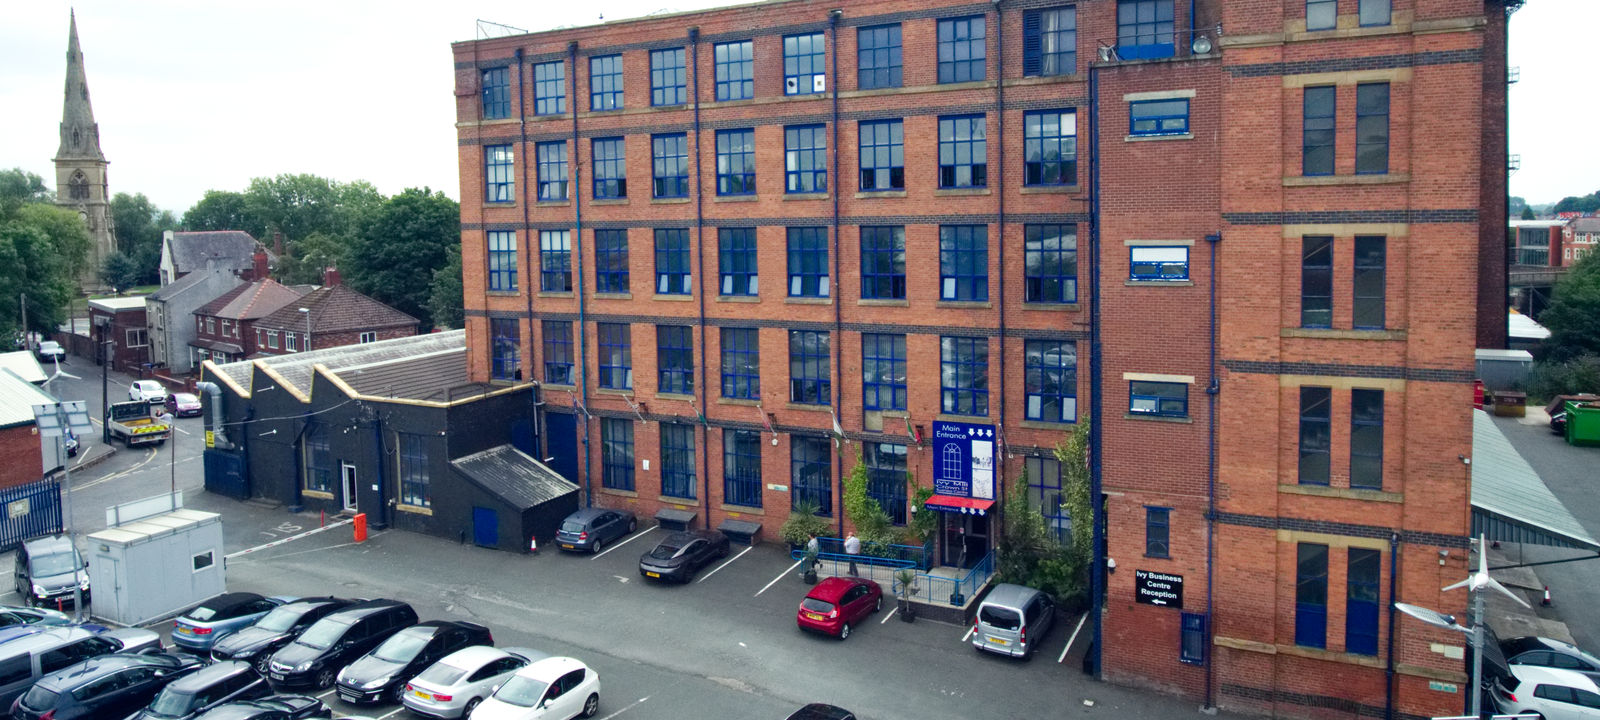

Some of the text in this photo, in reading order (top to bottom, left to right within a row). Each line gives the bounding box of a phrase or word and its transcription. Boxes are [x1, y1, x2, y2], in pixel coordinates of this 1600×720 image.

[936, 431, 967, 439] Entrance
[1136, 571, 1182, 583] Ivy Business
[1147, 581, 1171, 590] Centre
[1141, 588, 1177, 599] Reception
